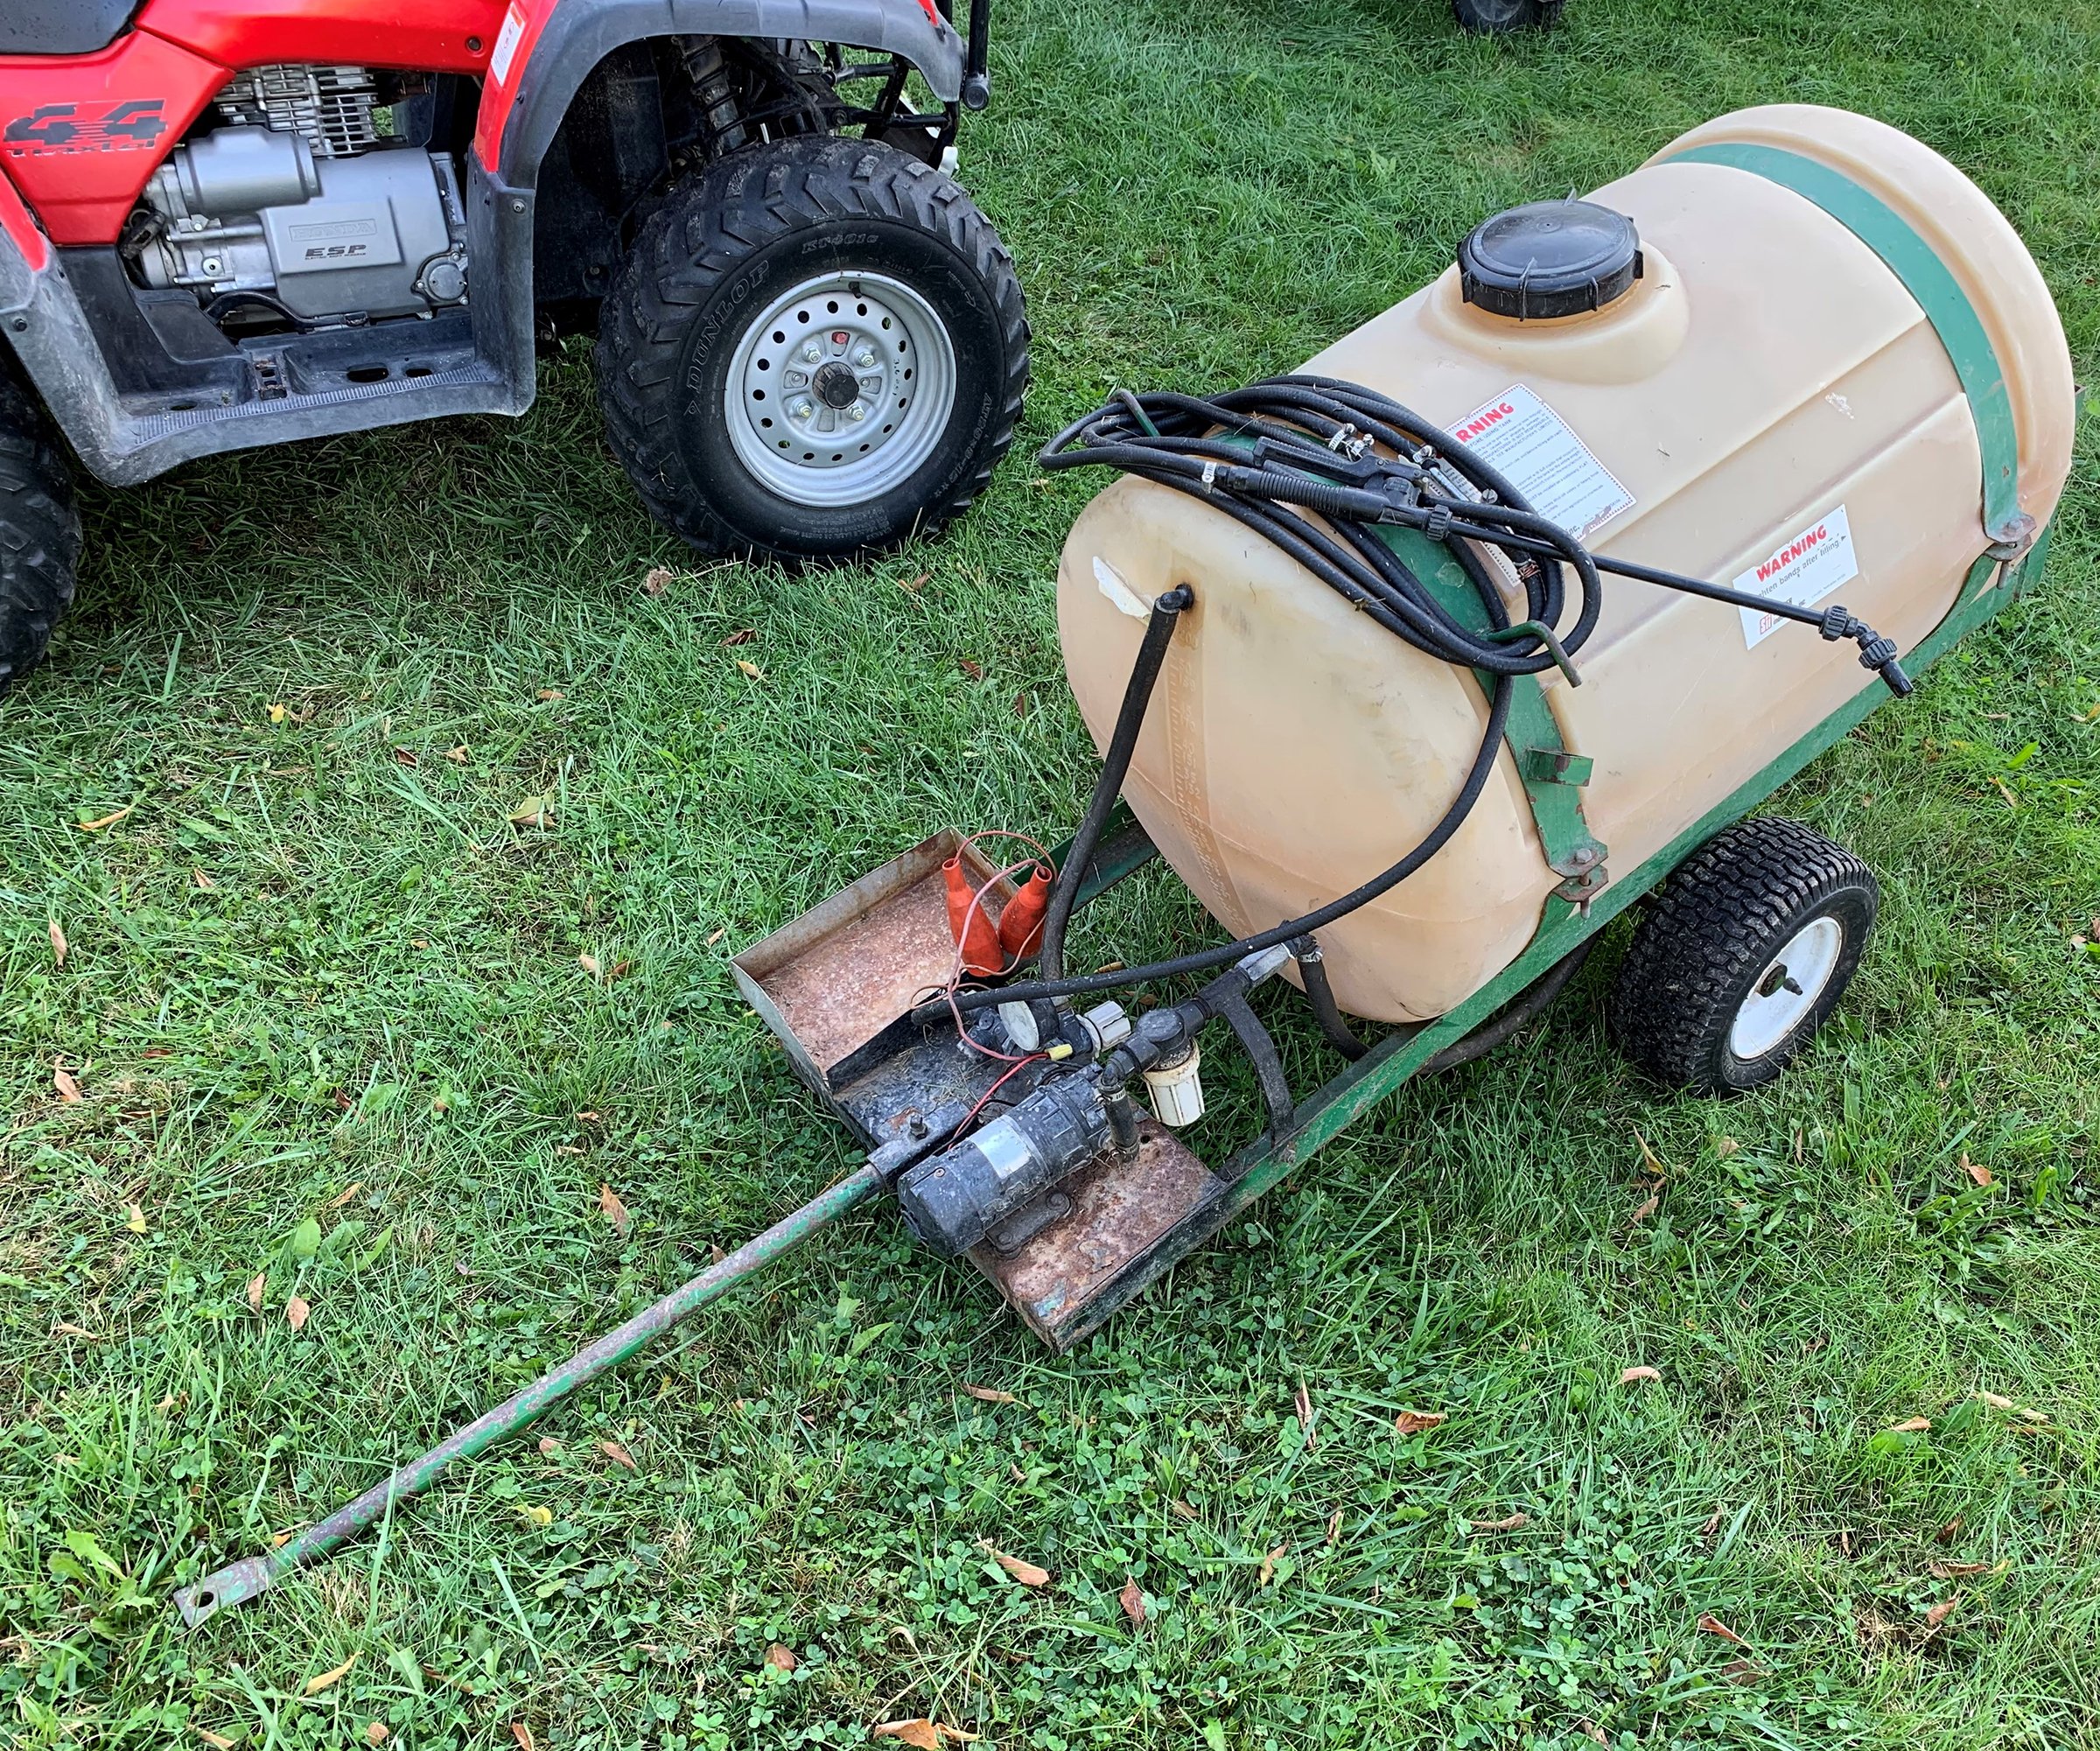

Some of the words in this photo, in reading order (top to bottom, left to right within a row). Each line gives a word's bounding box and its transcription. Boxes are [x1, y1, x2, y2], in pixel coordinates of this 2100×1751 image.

[305, 244, 367, 256] ESP
[687, 260, 769, 393] DUNLOP
[1456, 402, 1514, 443] RNING
[1756, 524, 1827, 583] WARNING
[1779, 566, 1801, 585] bands
[1802, 553, 1818, 569] after
